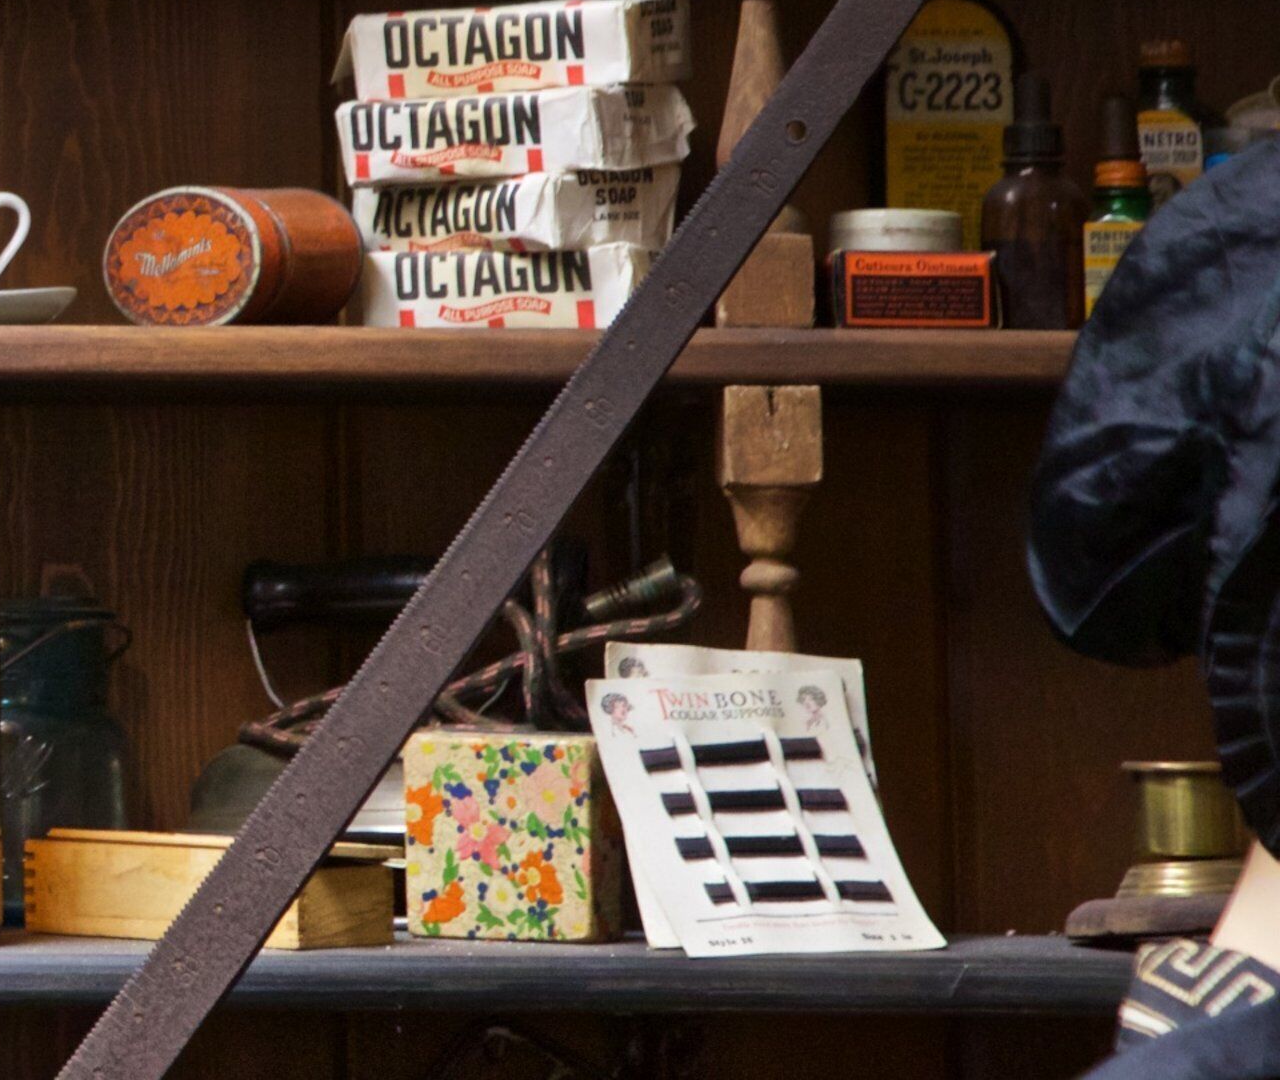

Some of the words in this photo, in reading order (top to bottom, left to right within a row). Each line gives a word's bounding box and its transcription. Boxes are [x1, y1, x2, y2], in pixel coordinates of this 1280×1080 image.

[383, 9, 586, 69] OCTAGON
[430, 72, 451, 86] ALL
[453, 64, 503, 86] PURPOSE
[507, 62, 538, 76] SOAP
[898, 70, 1004, 113] C-2223
[350, 94, 541, 152] OCTAGON
[577, 168, 654, 187] OCTAGON
[596, 187, 636, 207] SOAP
[395, 251, 592, 301] OCTAGON
[855, 258, 912, 272] Cuticura
[916, 259, 979, 272] Ointment
[442, 306, 462, 322] ALL
[464, 300, 514, 321] PURPOSE
[517, 298, 548, 311] SOAP
[648, 689, 710, 720] TWIN
[714, 689, 782, 709] BONE
[670, 710, 717, 721] COLLAR
[721, 706, 785, 720] SUPPORTS
